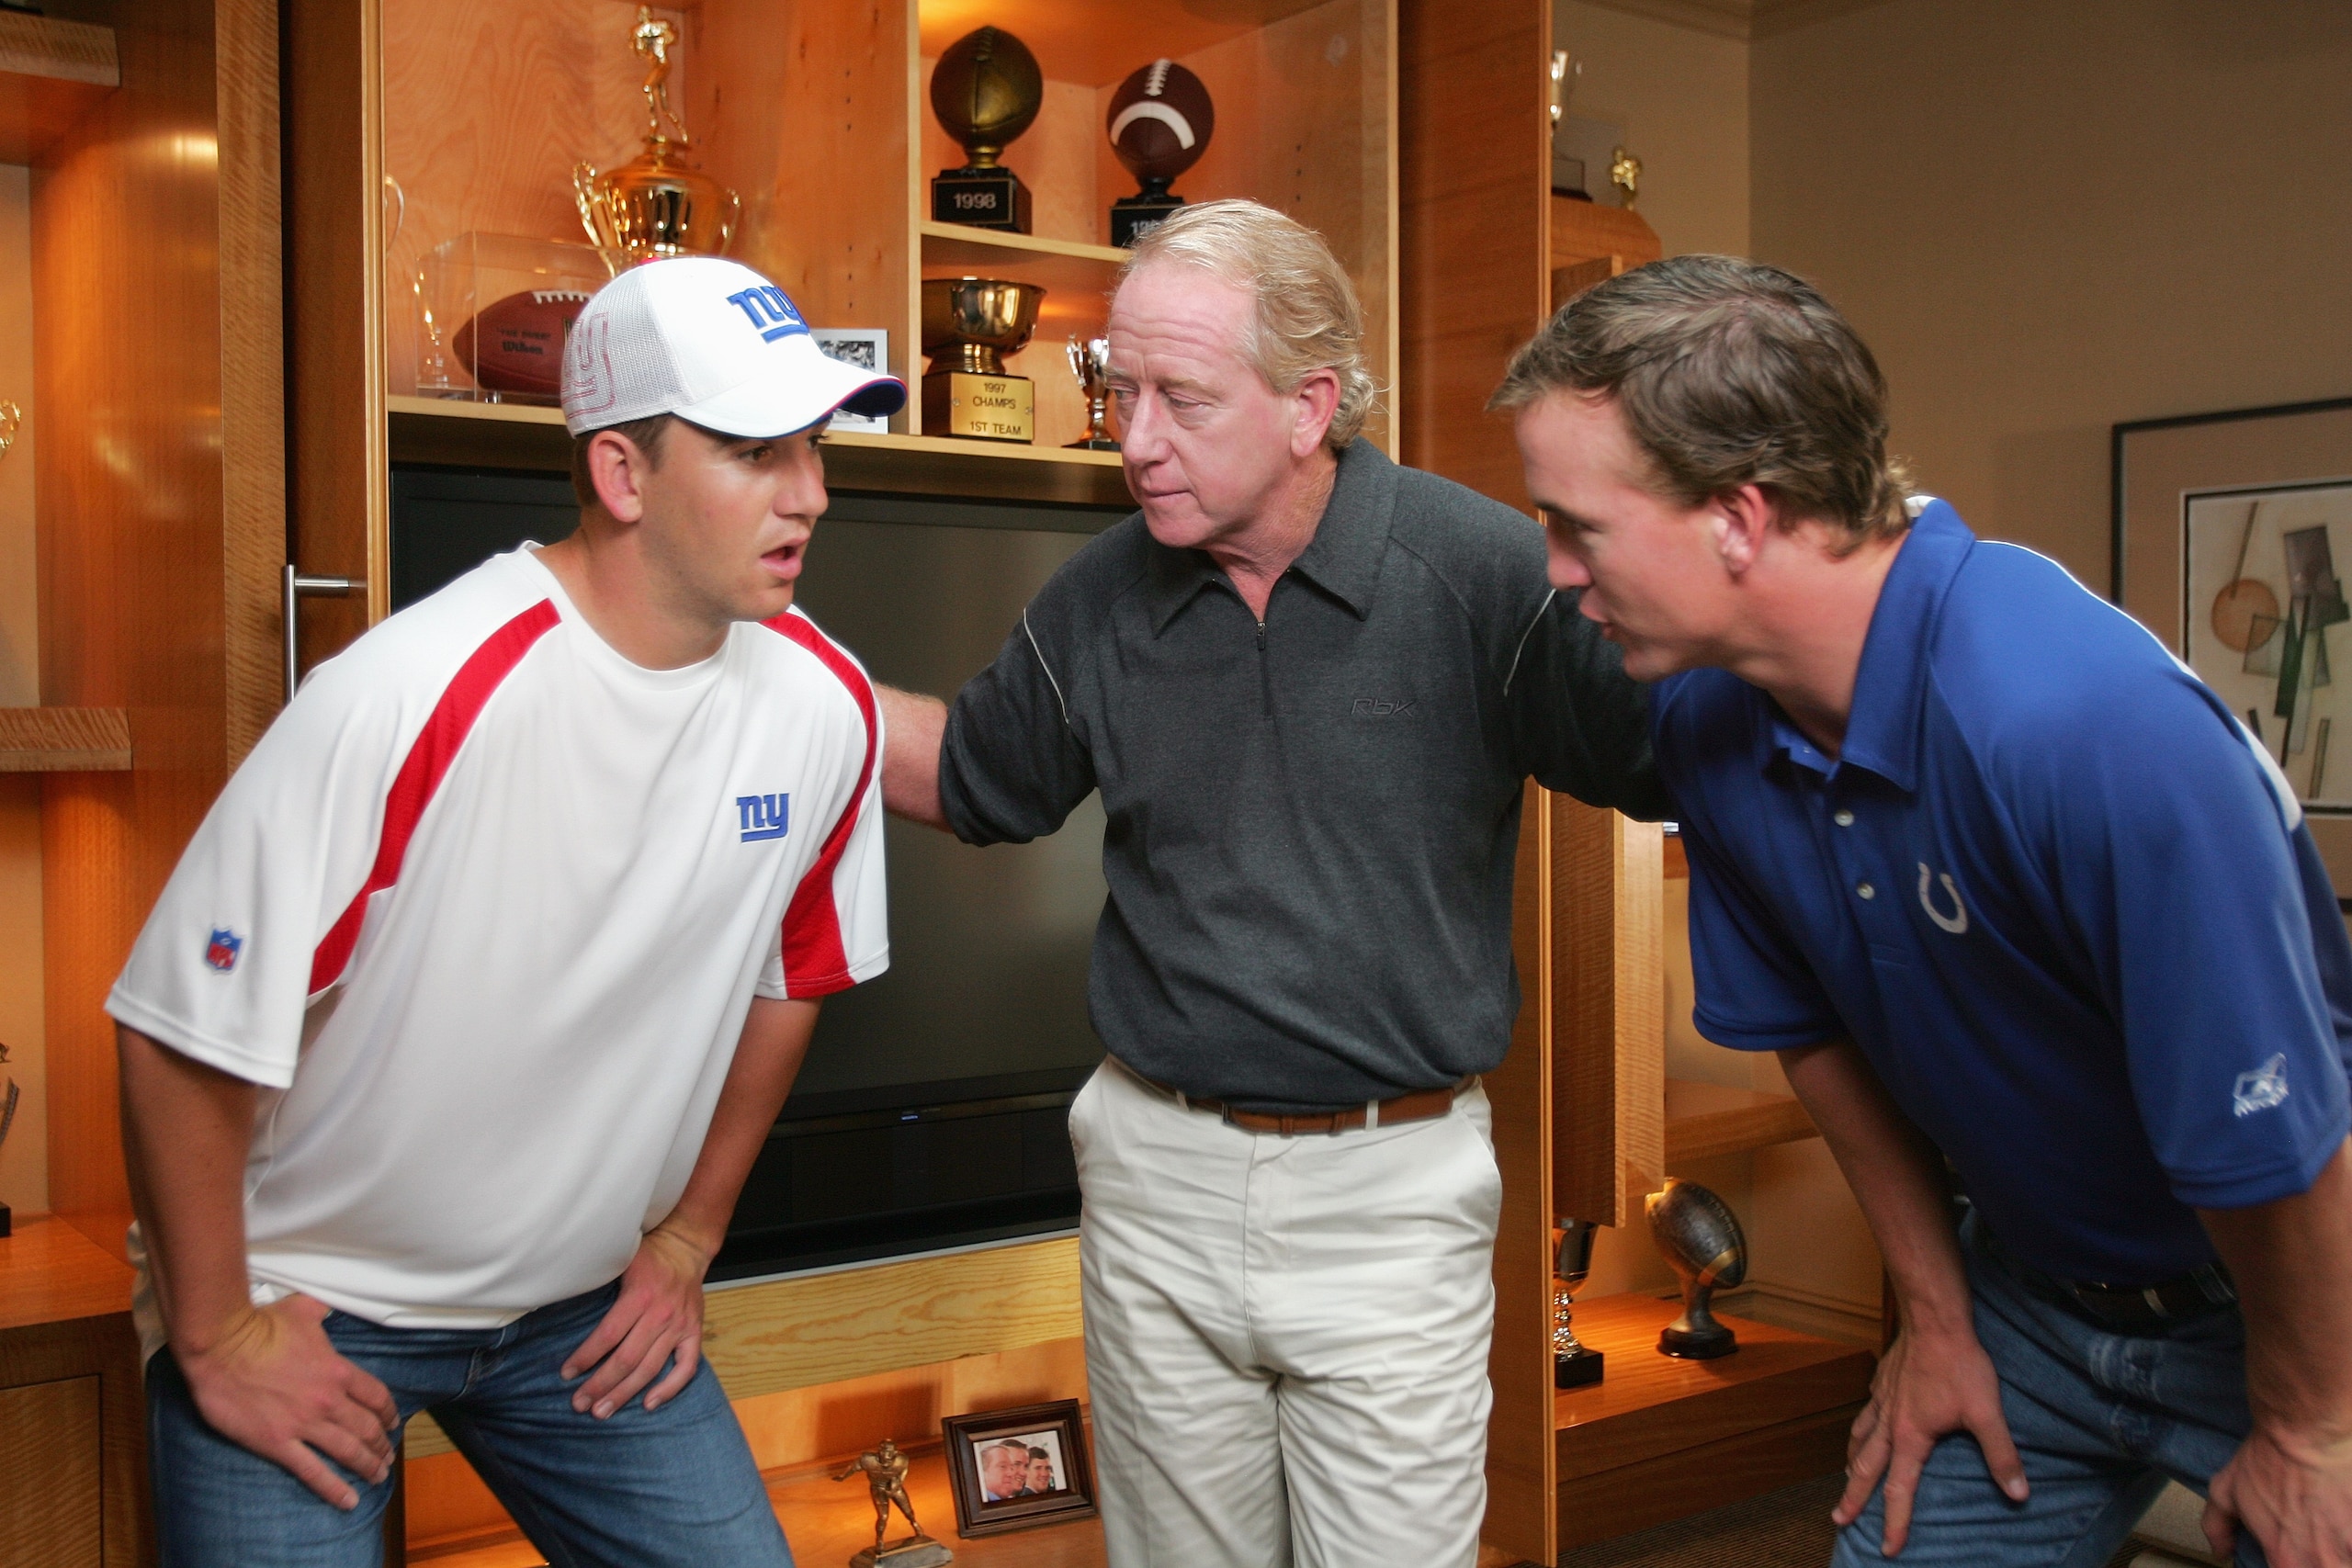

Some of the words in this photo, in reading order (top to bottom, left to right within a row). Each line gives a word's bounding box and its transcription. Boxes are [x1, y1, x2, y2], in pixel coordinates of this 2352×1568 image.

[954, 193, 996, 209] 1998
[984, 382, 1007, 394] 1997
[972, 396, 1016, 410] CHAMPS
[970, 421, 988, 433] 1ST
[992, 423, 1022, 435] TEAM
